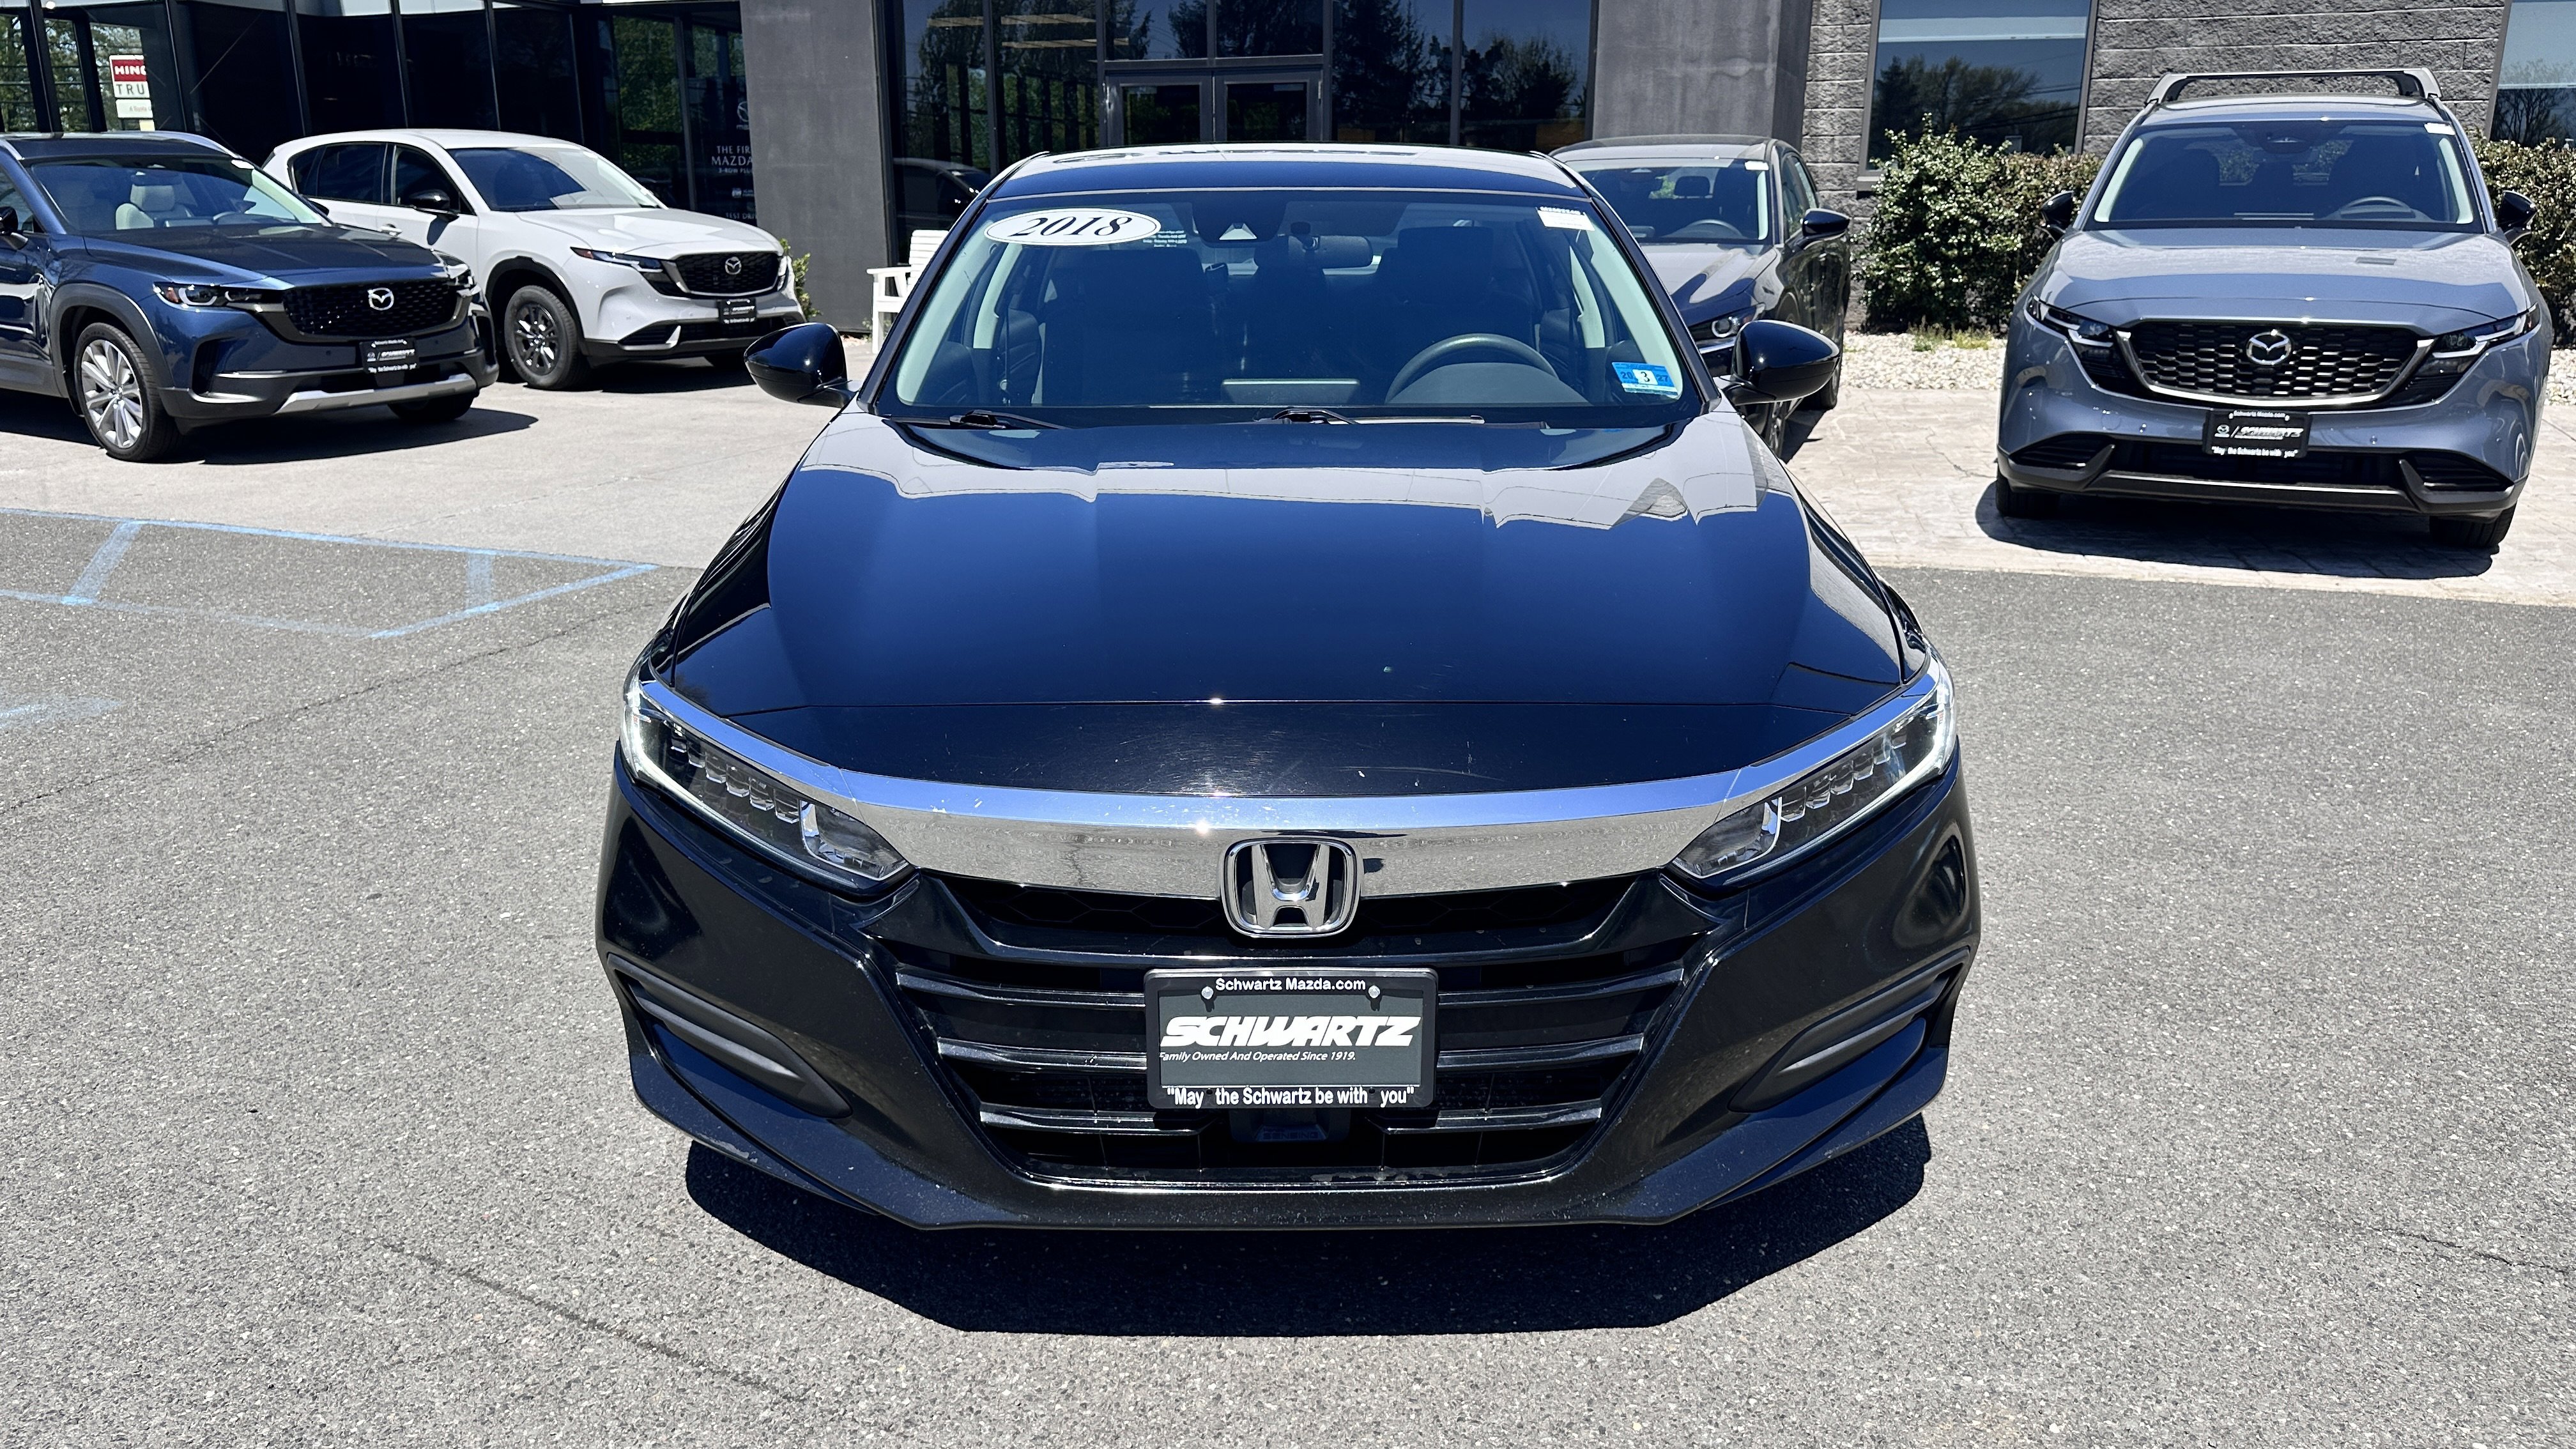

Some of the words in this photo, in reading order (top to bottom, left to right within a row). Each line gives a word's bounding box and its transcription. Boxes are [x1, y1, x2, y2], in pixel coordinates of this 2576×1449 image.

[717, 146, 733, 154] THE
[1008, 216, 1133, 237] 2018
[1641, 371, 1650, 382] 3
[1215, 977, 1282, 990] Schwartz
[1285, 977, 1366, 990] Mazda.com
[1160, 1016, 1422, 1046] SCHWARTZ
[1159, 1052, 1191, 1062] Family
[1192, 1052, 1229, 1061] Owned
[1230, 1052, 1253, 1061] And
[1253, 1052, 1300, 1062] Operated
[1301, 1052, 1328, 1061] Since
[1330, 1052, 1356, 1061] 1919.
[1167, 1087, 1204, 1109] "May
[1215, 1087, 1239, 1105] the
[1243, 1087, 1312, 1105] Schwartz
[1315, 1087, 1333, 1105] be
[1337, 1087, 1367, 1105] with
[1380, 1086, 1414, 1108] you"
